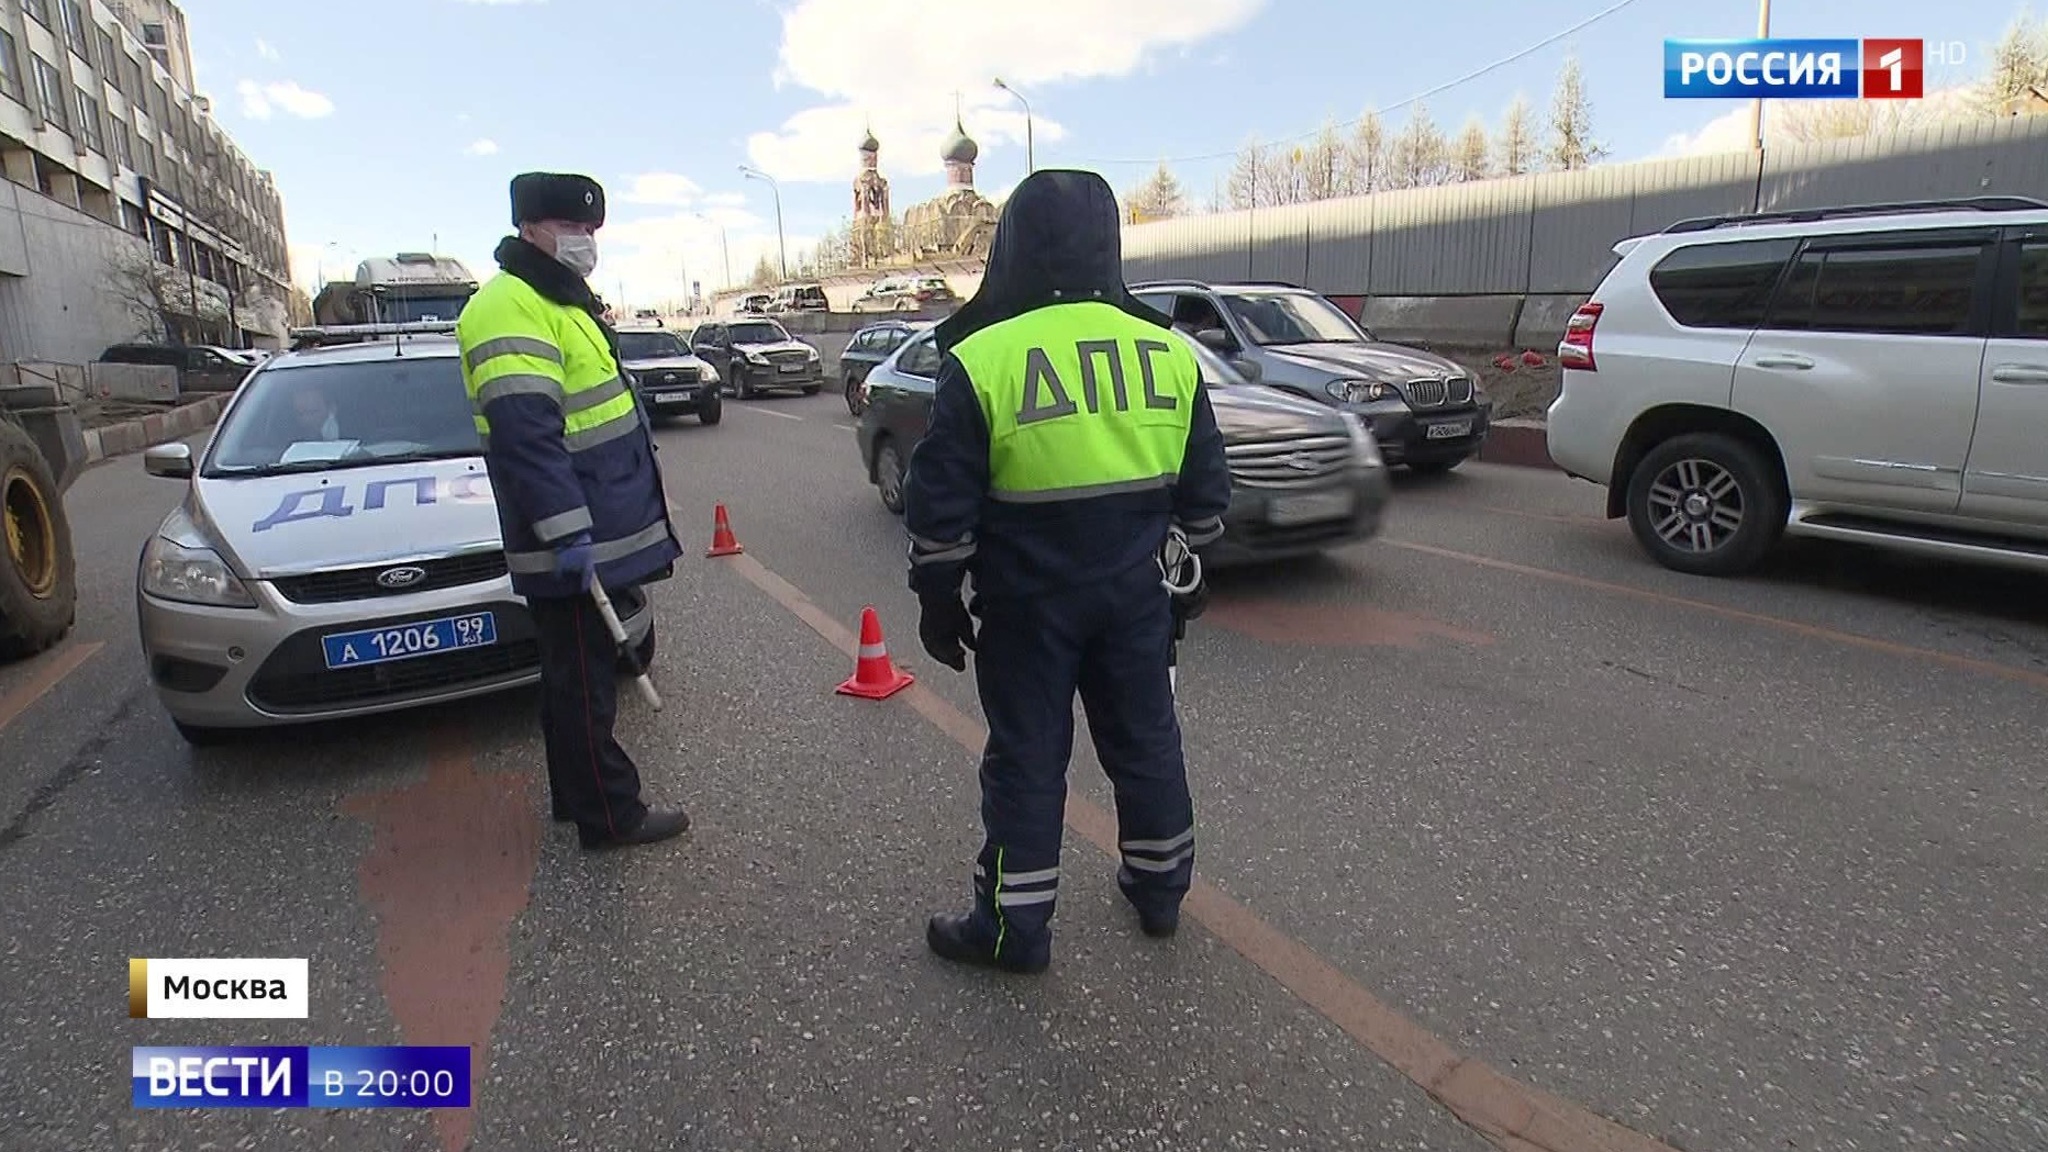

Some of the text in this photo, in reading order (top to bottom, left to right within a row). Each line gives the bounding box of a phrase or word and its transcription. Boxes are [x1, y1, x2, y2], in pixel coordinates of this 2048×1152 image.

[1017, 339, 1178, 424] ДПС
[387, 571, 414, 584] Ford
[371, 624, 440, 657] 1206
[457, 617, 483, 635] 99
